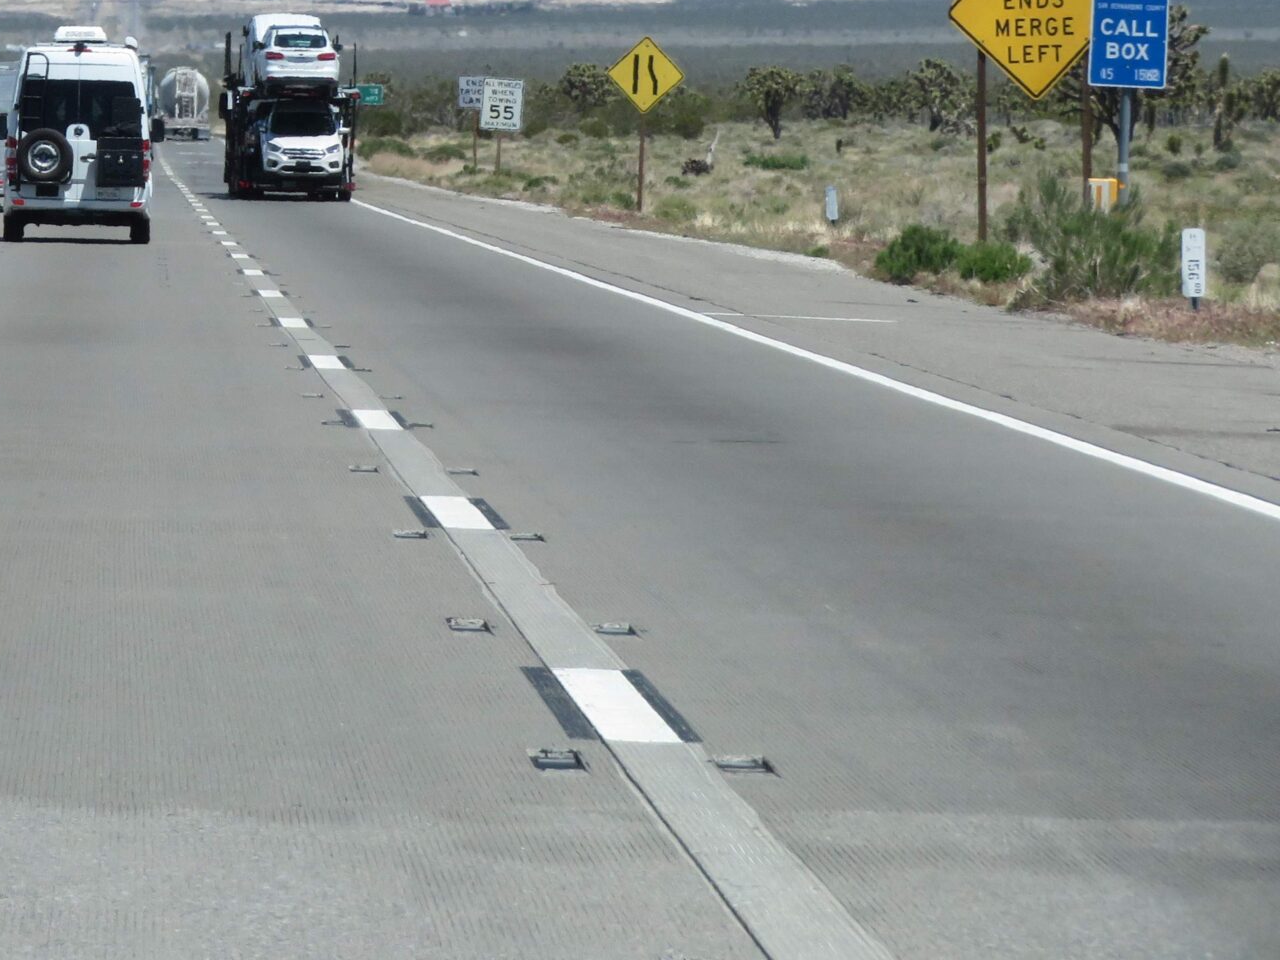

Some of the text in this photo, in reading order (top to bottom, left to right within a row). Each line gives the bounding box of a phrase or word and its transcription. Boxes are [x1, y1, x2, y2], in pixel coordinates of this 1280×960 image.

[995, 16, 1075, 38] MERGE
[1100, 17, 1159, 38] CALL
[1007, 44, 1063, 64] LEFT
[1105, 41, 1150, 61] BOX
[460, 88, 483, 96] TRUC
[463, 96, 481, 104] LAN
[488, 96, 517, 104] TOWING
[489, 104, 515, 120] 55
